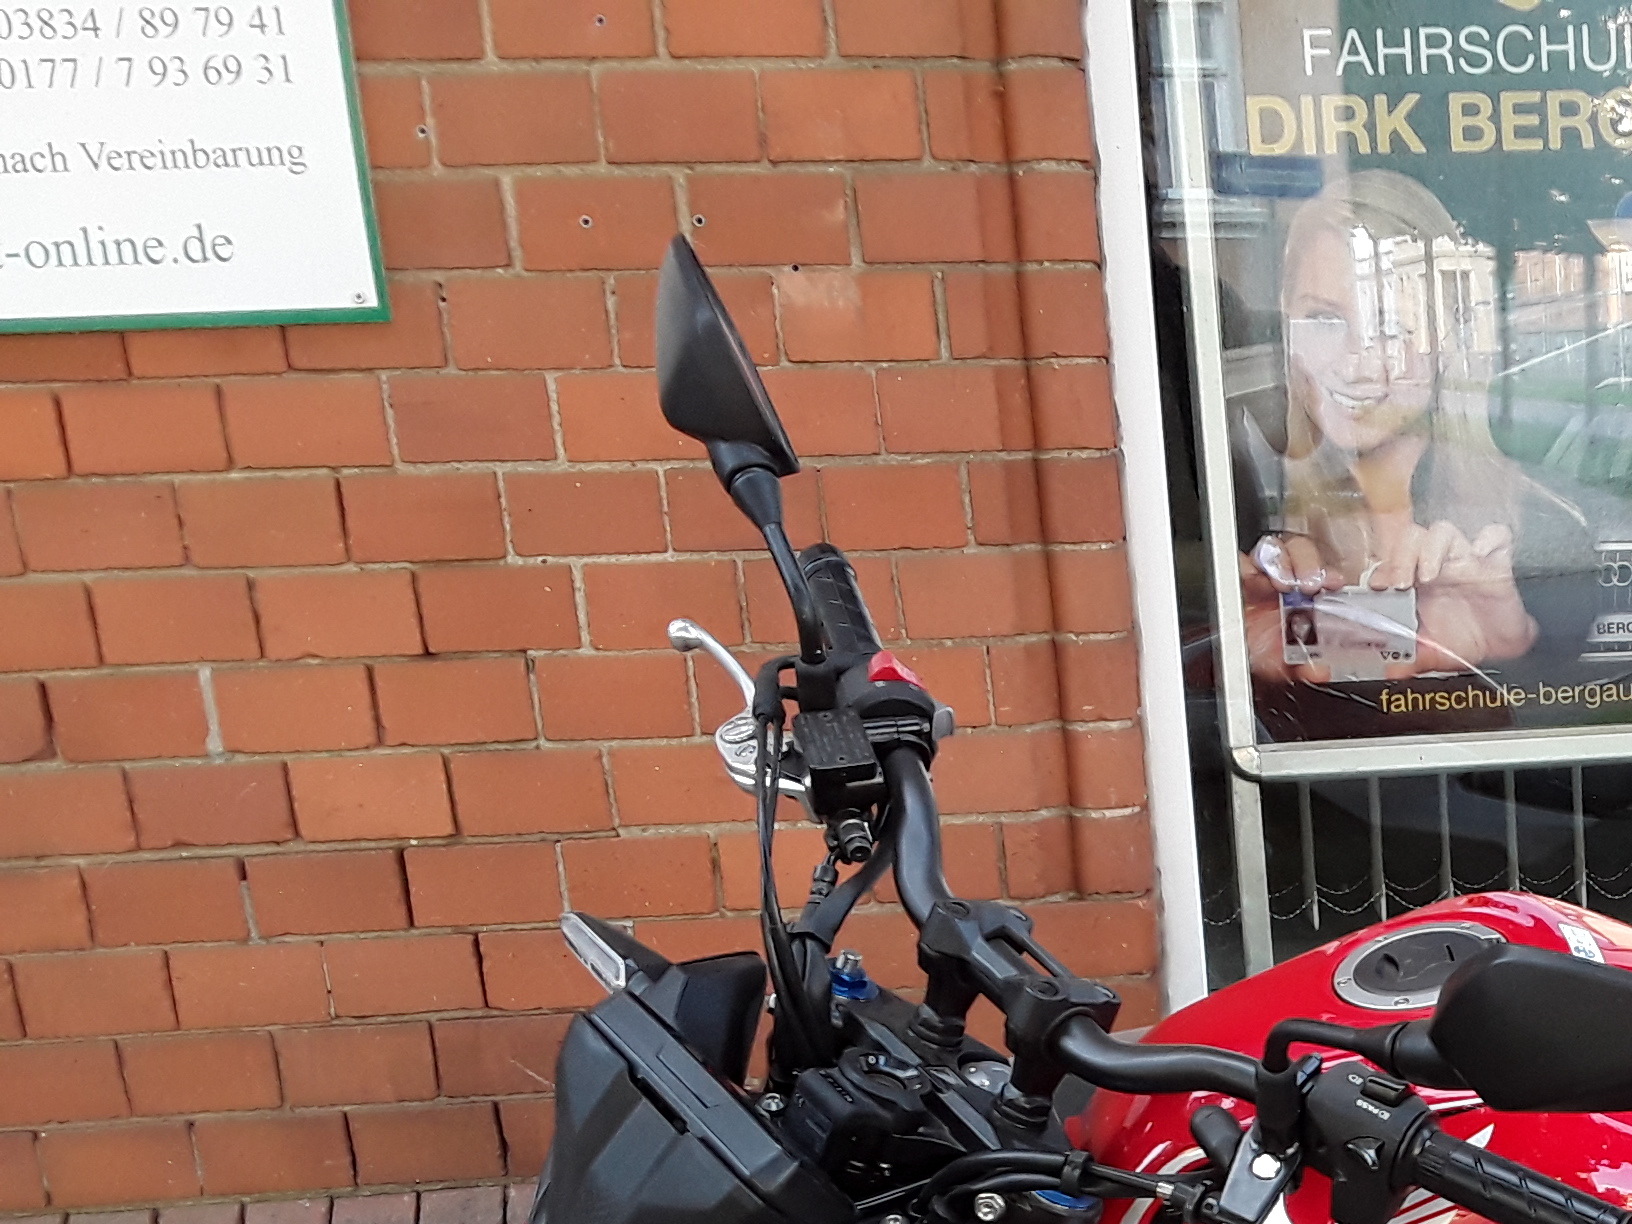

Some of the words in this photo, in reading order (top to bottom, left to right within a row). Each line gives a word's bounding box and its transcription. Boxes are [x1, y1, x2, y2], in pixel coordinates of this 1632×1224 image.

[0, 7, 102, 40] 03834
[115, 6, 124, 39] /
[138, 6, 181, 39] 89
[192, 6, 235, 38] 79
[248, 5, 286, 37] 41
[0, 57, 79, 89] 0177
[94, 56, 103, 87] /
[114, 57, 133, 87] 7
[148, 55, 190, 87] 93
[202, 54, 243, 86] 69
[254, 53, 294, 84] 31
[1245, 92, 1428, 157] DIRK
[0, 141, 71, 174] nach
[77, 138, 308, 175] Vereinbarung
[0, 224, 235, 269] -online.de
